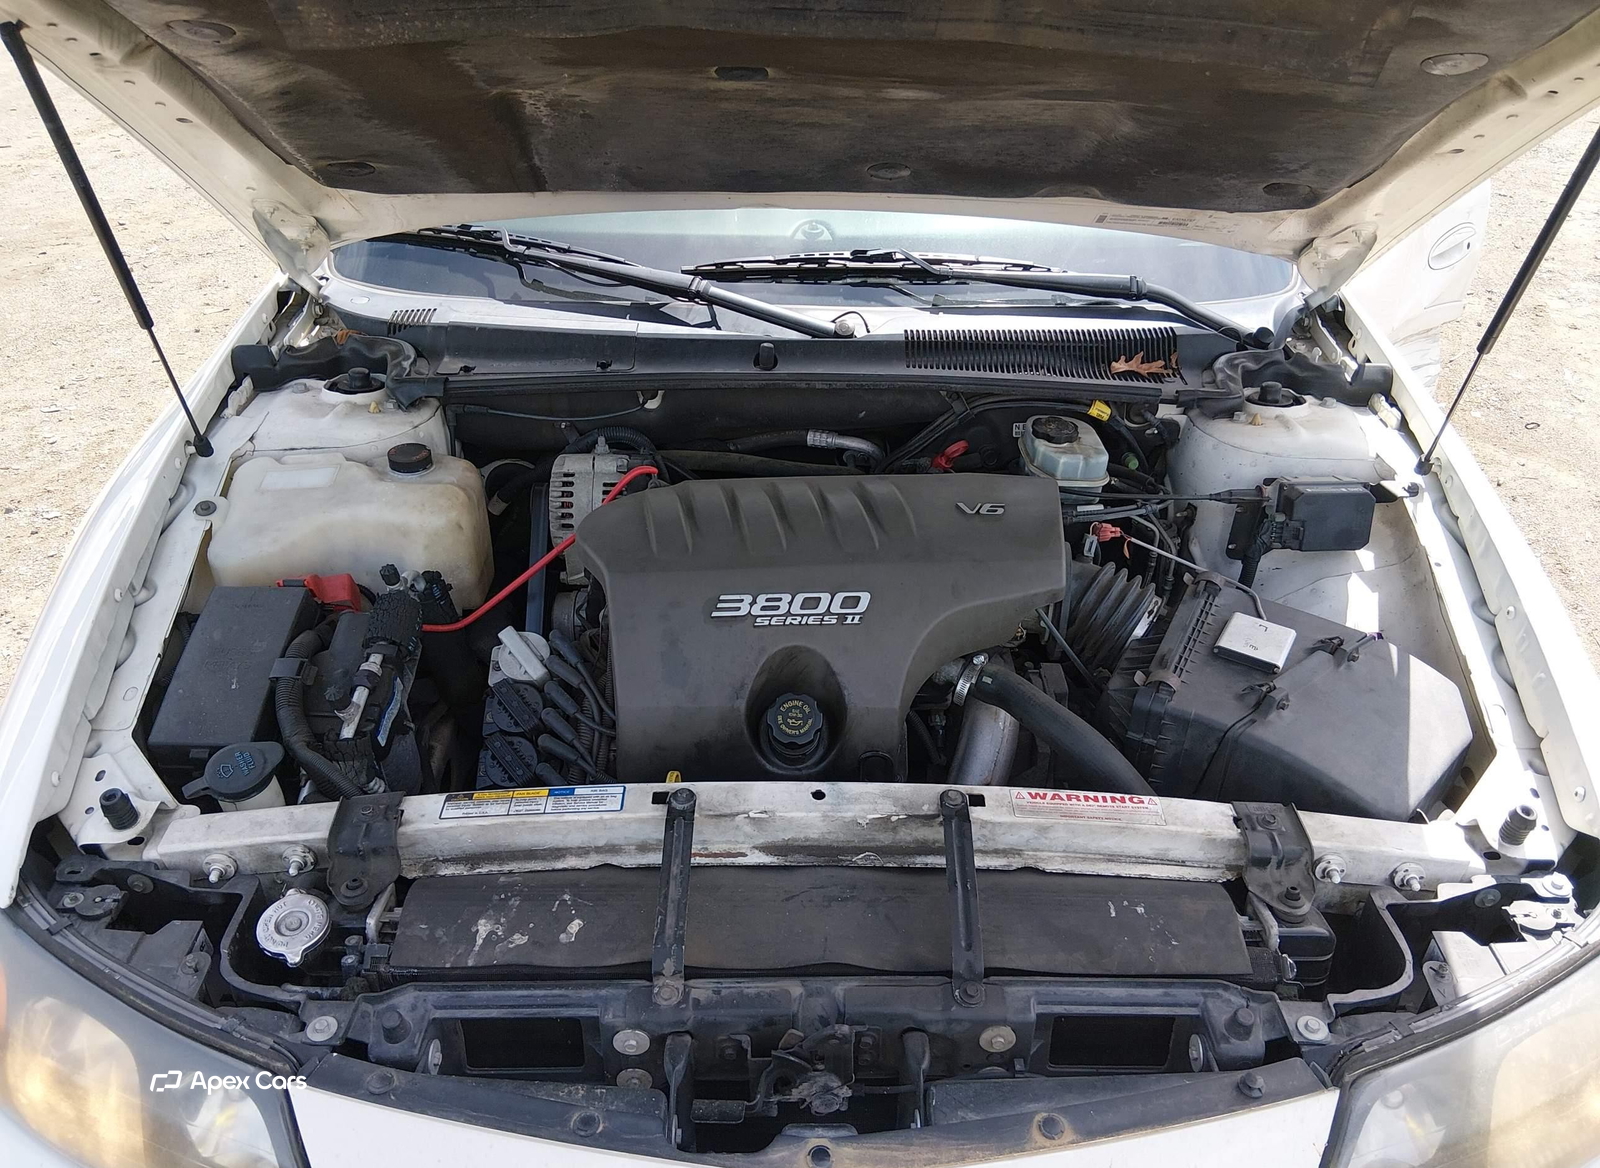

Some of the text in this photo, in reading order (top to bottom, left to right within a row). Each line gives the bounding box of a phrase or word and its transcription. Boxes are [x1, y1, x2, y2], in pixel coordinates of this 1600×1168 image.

[956, 502, 1006, 515] V6
[710, 591, 872, 617] 3800
[754, 614, 864, 627] SERIES II
[780, 700, 811, 714] ENGINE OIL
[234, 751, 250, 776] WASHER
[243, 752, 256, 769] FLUID
[1027, 791, 1145, 805] WARNING
